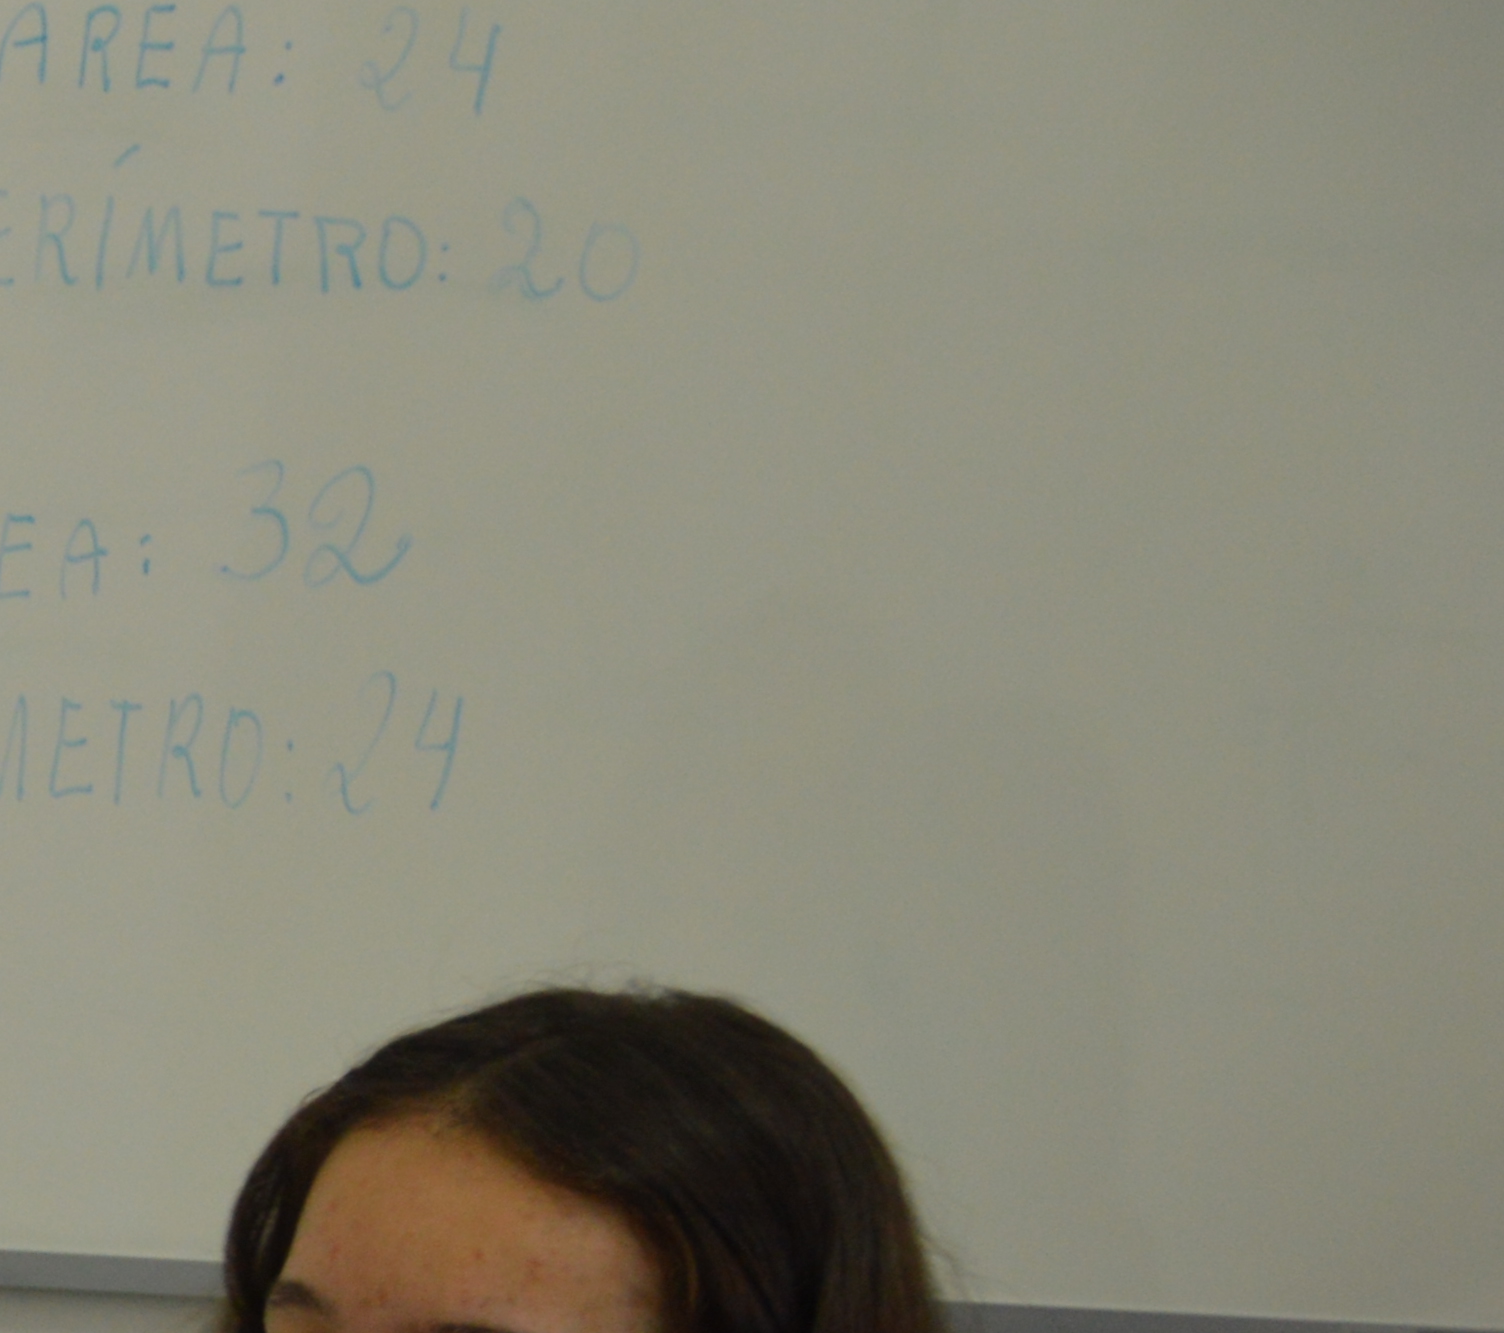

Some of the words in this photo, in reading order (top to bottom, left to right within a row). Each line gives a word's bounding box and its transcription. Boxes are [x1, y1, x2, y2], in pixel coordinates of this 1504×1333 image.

[358, 4, 502, 116] 24
[494, 196, 642, 304] 20
[214, 458, 414, 588] 32
[324, 670, 466, 816] 24
